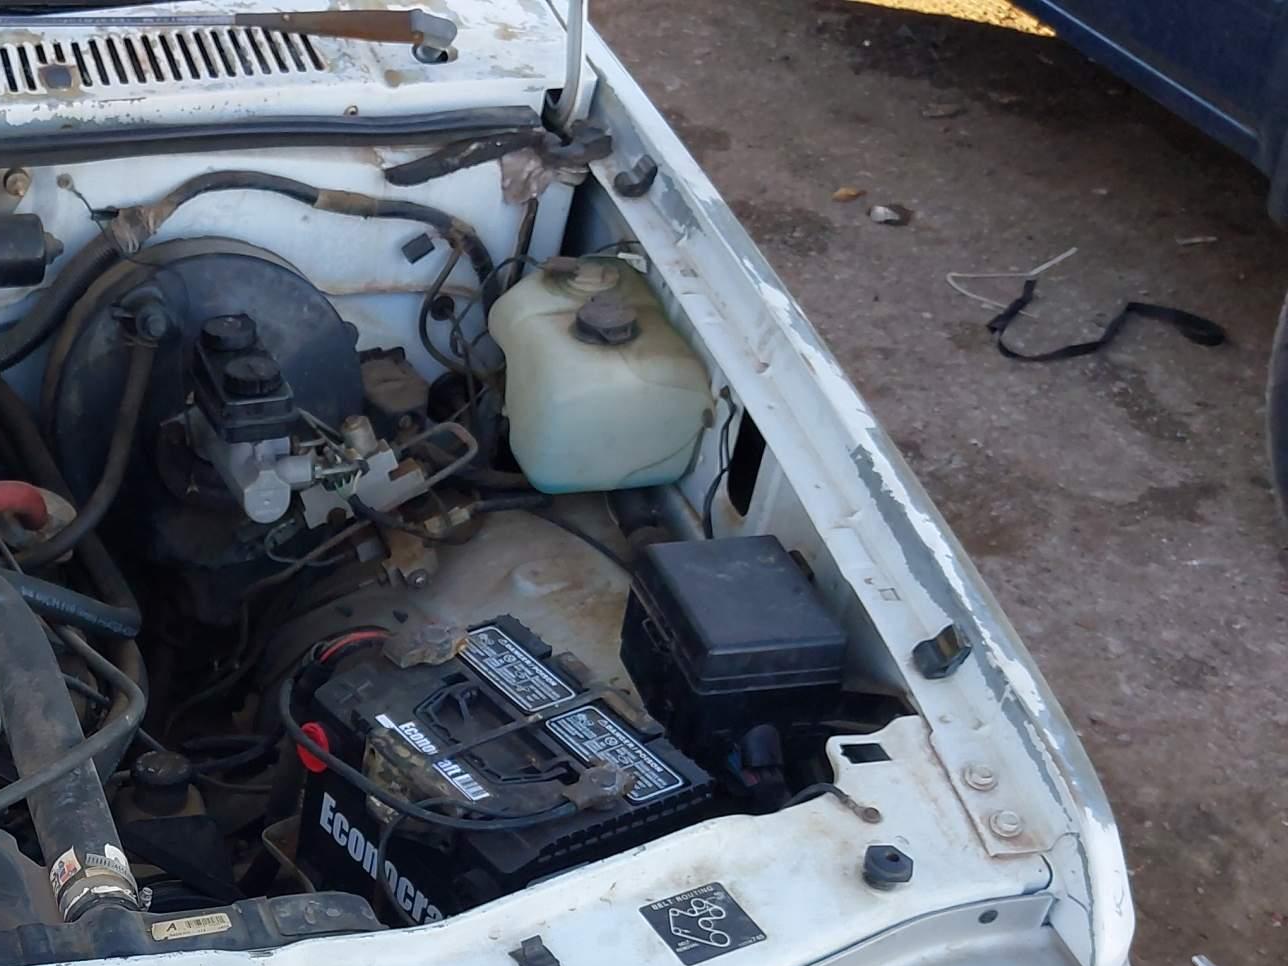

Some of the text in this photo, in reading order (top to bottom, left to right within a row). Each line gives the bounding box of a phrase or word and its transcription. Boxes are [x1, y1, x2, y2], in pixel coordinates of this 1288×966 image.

[399, 721, 462, 776] Econoaft
[651, 898, 673, 911] BELT
[676, 885, 714, 903] ROUTING
[166, 922, 177, 932] A
